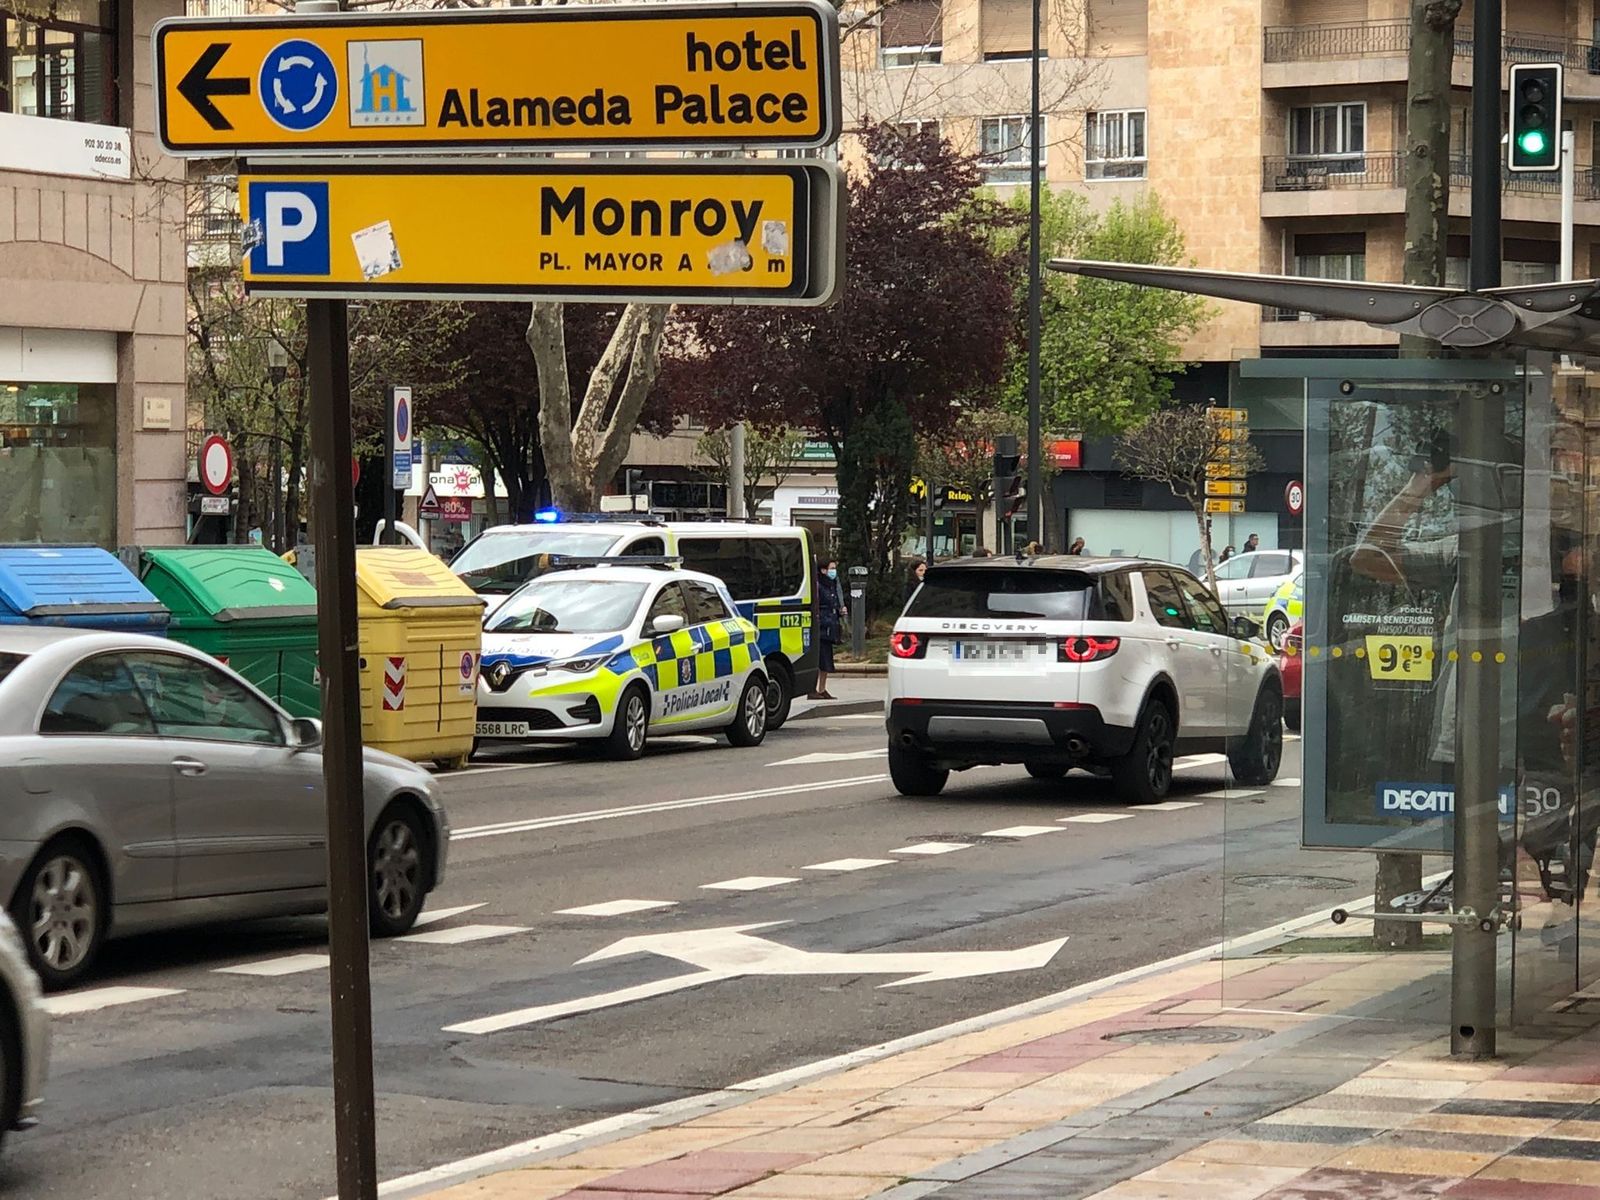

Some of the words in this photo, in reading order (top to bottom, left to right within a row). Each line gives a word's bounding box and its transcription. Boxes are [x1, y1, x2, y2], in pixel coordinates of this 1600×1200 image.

[686, 30, 807, 72] hotel
[437, 88, 632, 128] Alameda
[655, 83, 808, 125] Palace
[540, 186, 764, 248] Monroy
[540, 253, 571, 270] PL.
[584, 253, 663, 271] MAYOR
[677, 254, 693, 272] A
[767, 258, 785, 273] m
[1291, 491, 1301, 504] 30
[942, 622, 1039, 632] DISCOVERY
[1342, 615, 1382, 624] CAMISETA
[1383, 615, 1435, 625] SENDERISMO
[670, 690, 699, 714] Policía
[700, 684, 723, 705] Local
[476, 722, 500, 735] 5568
[504, 723, 525, 735] LRC
